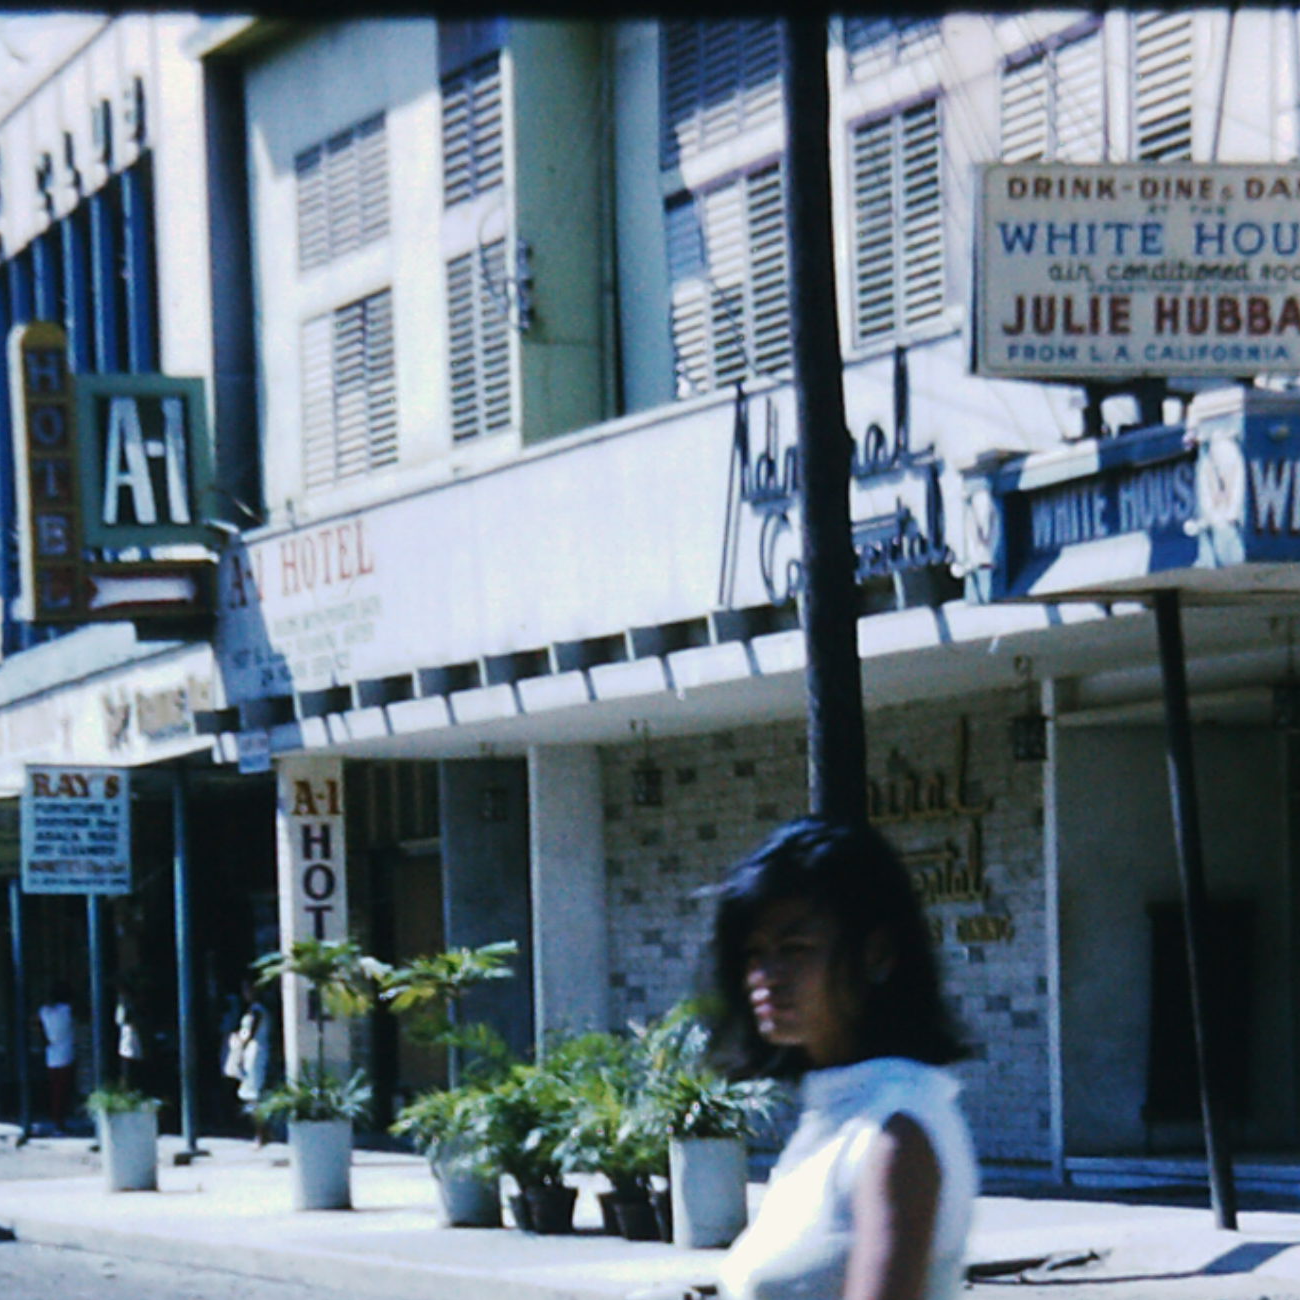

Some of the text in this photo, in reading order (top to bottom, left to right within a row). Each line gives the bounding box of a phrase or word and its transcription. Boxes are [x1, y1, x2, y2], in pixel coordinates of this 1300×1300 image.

[997, 221, 1163, 255] WHITE
[1002, 294, 1132, 335] JULIE
[1007, 344, 1078, 362] FROM
[1144, 344, 1289, 363] CALIFORNIA
[27, 353, 72, 610] HOTEL
[1119, 463, 1196, 533] HOUS
[280, 518, 375, 598] HOTEL
[302, 824, 337, 1021] HOTL
